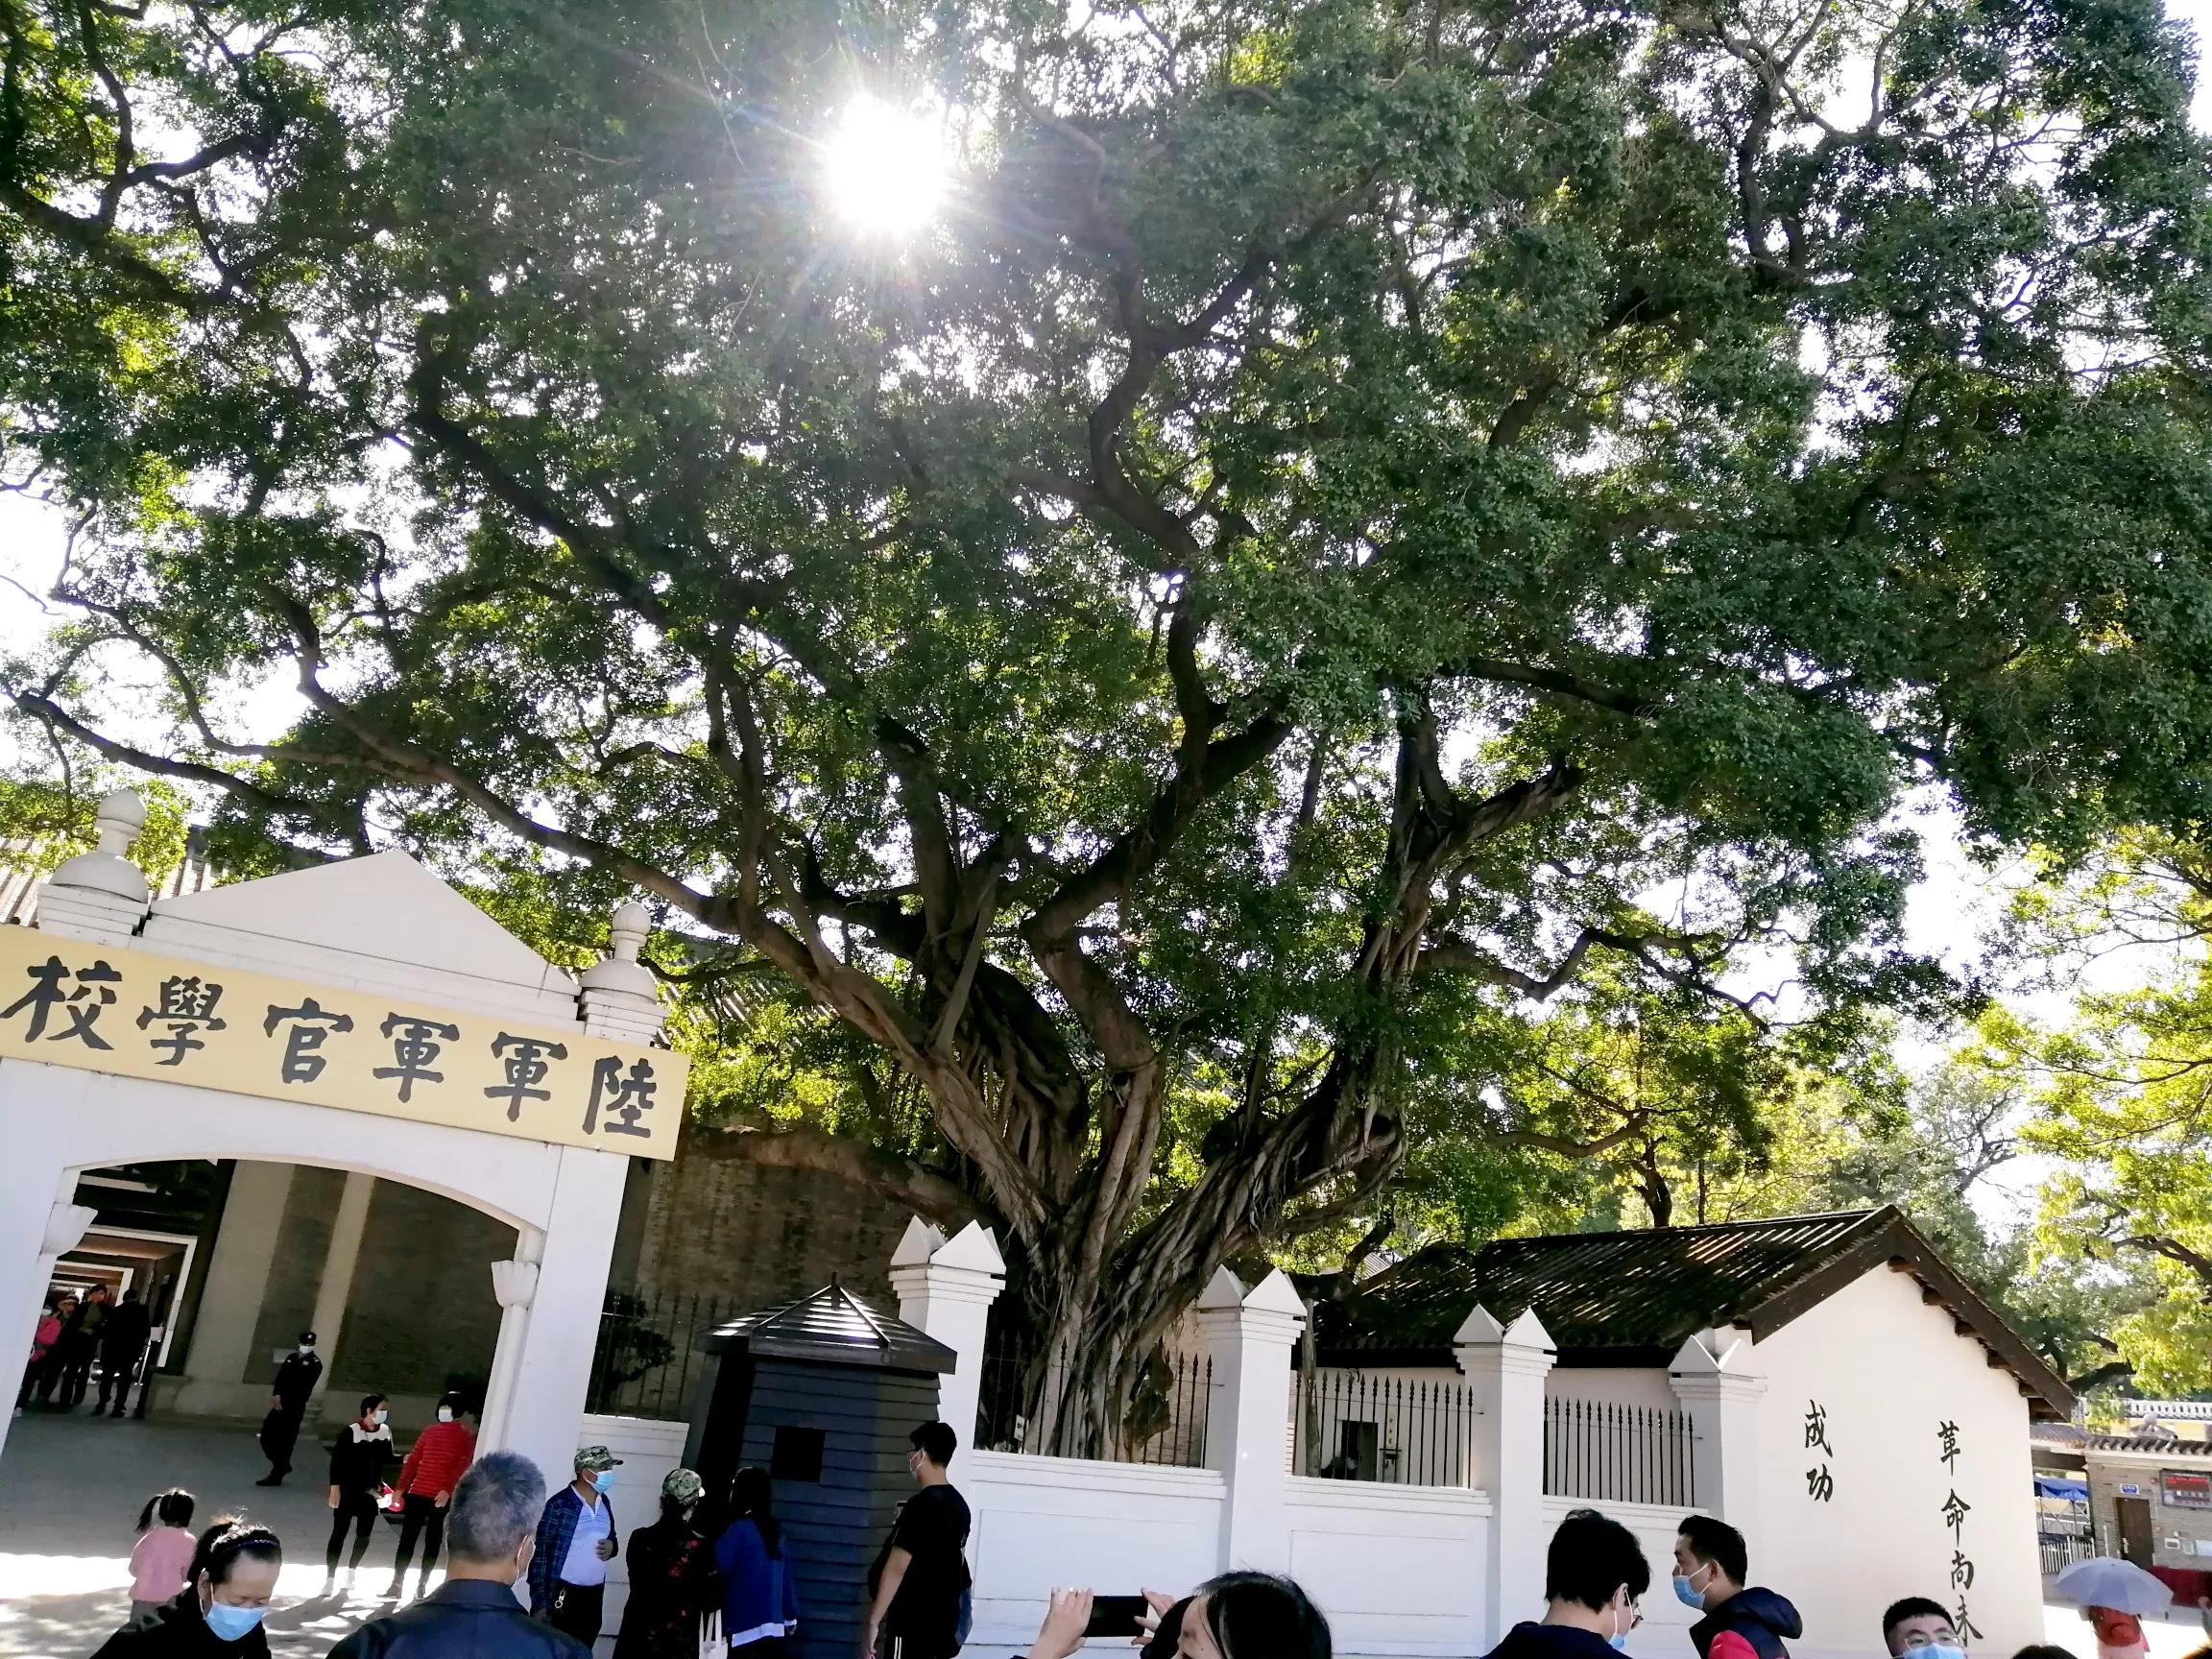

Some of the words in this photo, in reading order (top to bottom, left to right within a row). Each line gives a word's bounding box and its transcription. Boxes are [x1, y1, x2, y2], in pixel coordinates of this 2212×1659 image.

[1804, 1399, 1834, 1503] 成功
[1937, 1420, 1984, 1647] 革命尚未
